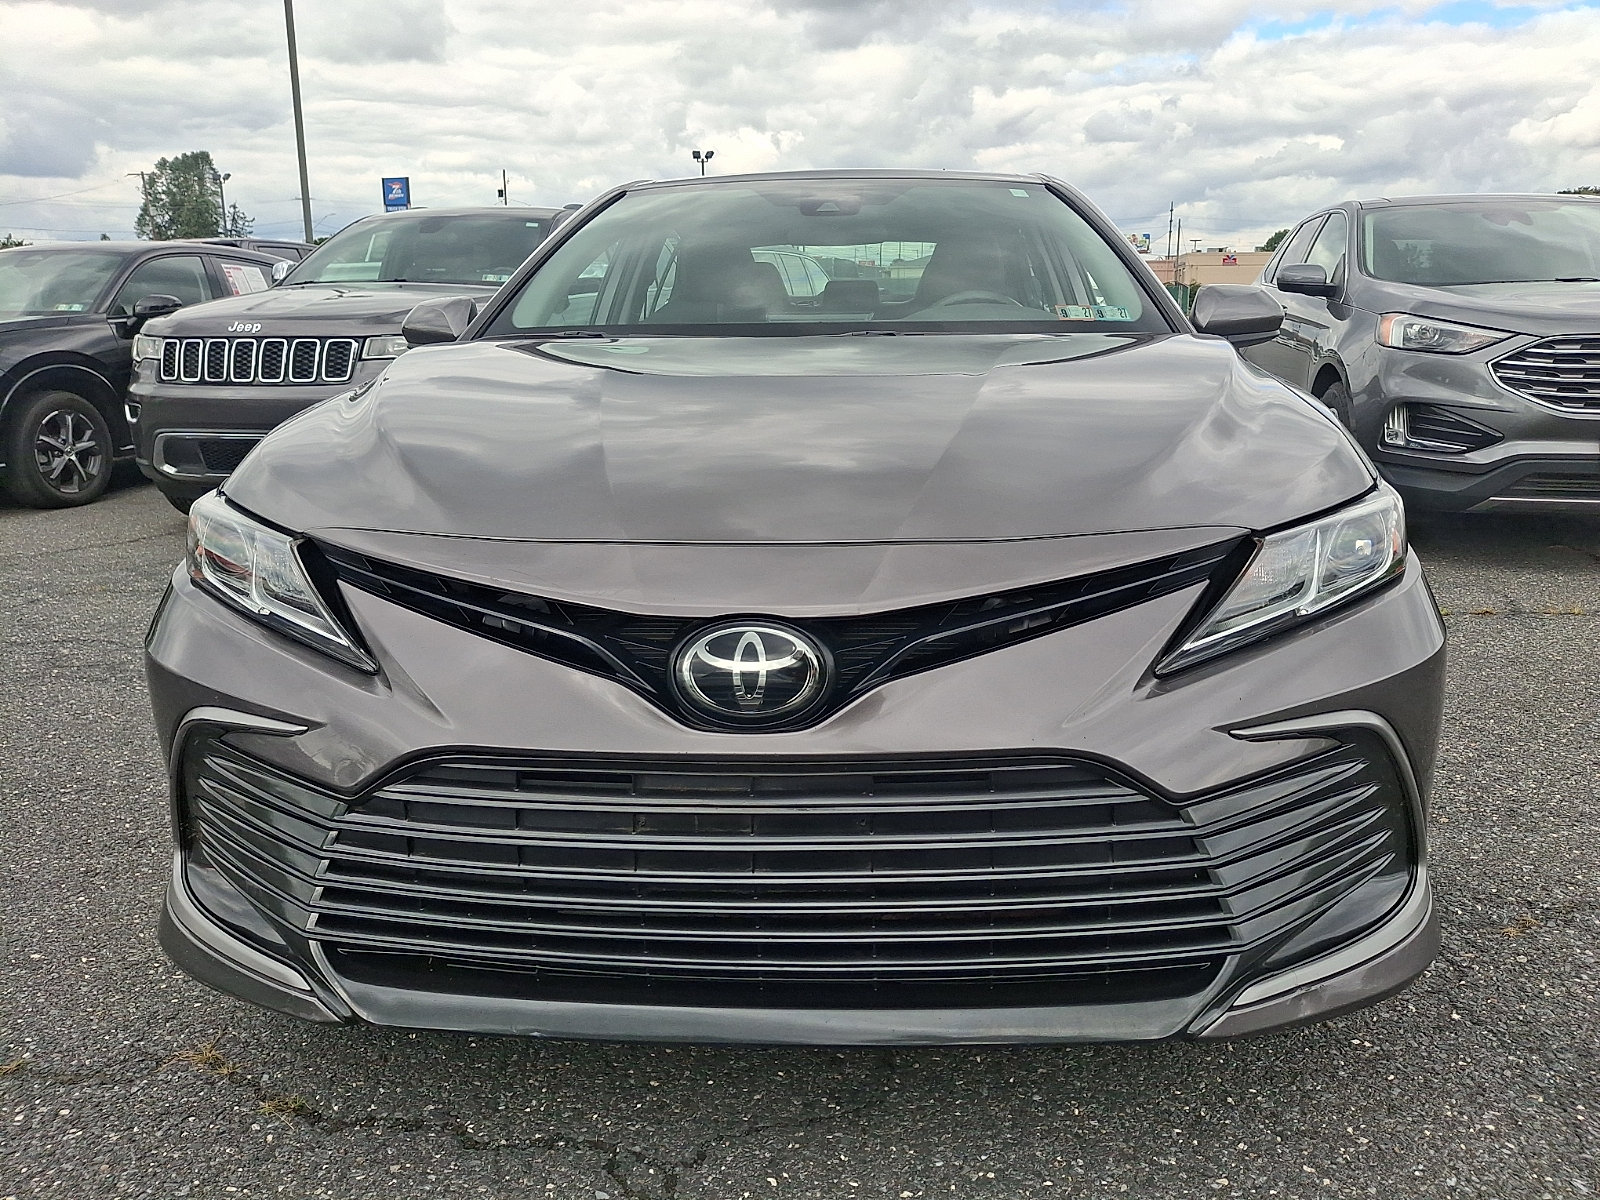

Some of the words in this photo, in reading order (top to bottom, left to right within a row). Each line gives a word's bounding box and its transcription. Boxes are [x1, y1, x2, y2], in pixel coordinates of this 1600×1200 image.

[1061, 308, 1068, 318] 9
[1082, 307, 1092, 318] 27
[1097, 309, 1104, 318] 9
[1118, 307, 1128, 318] 27
[228, 321, 262, 334] Jeep
